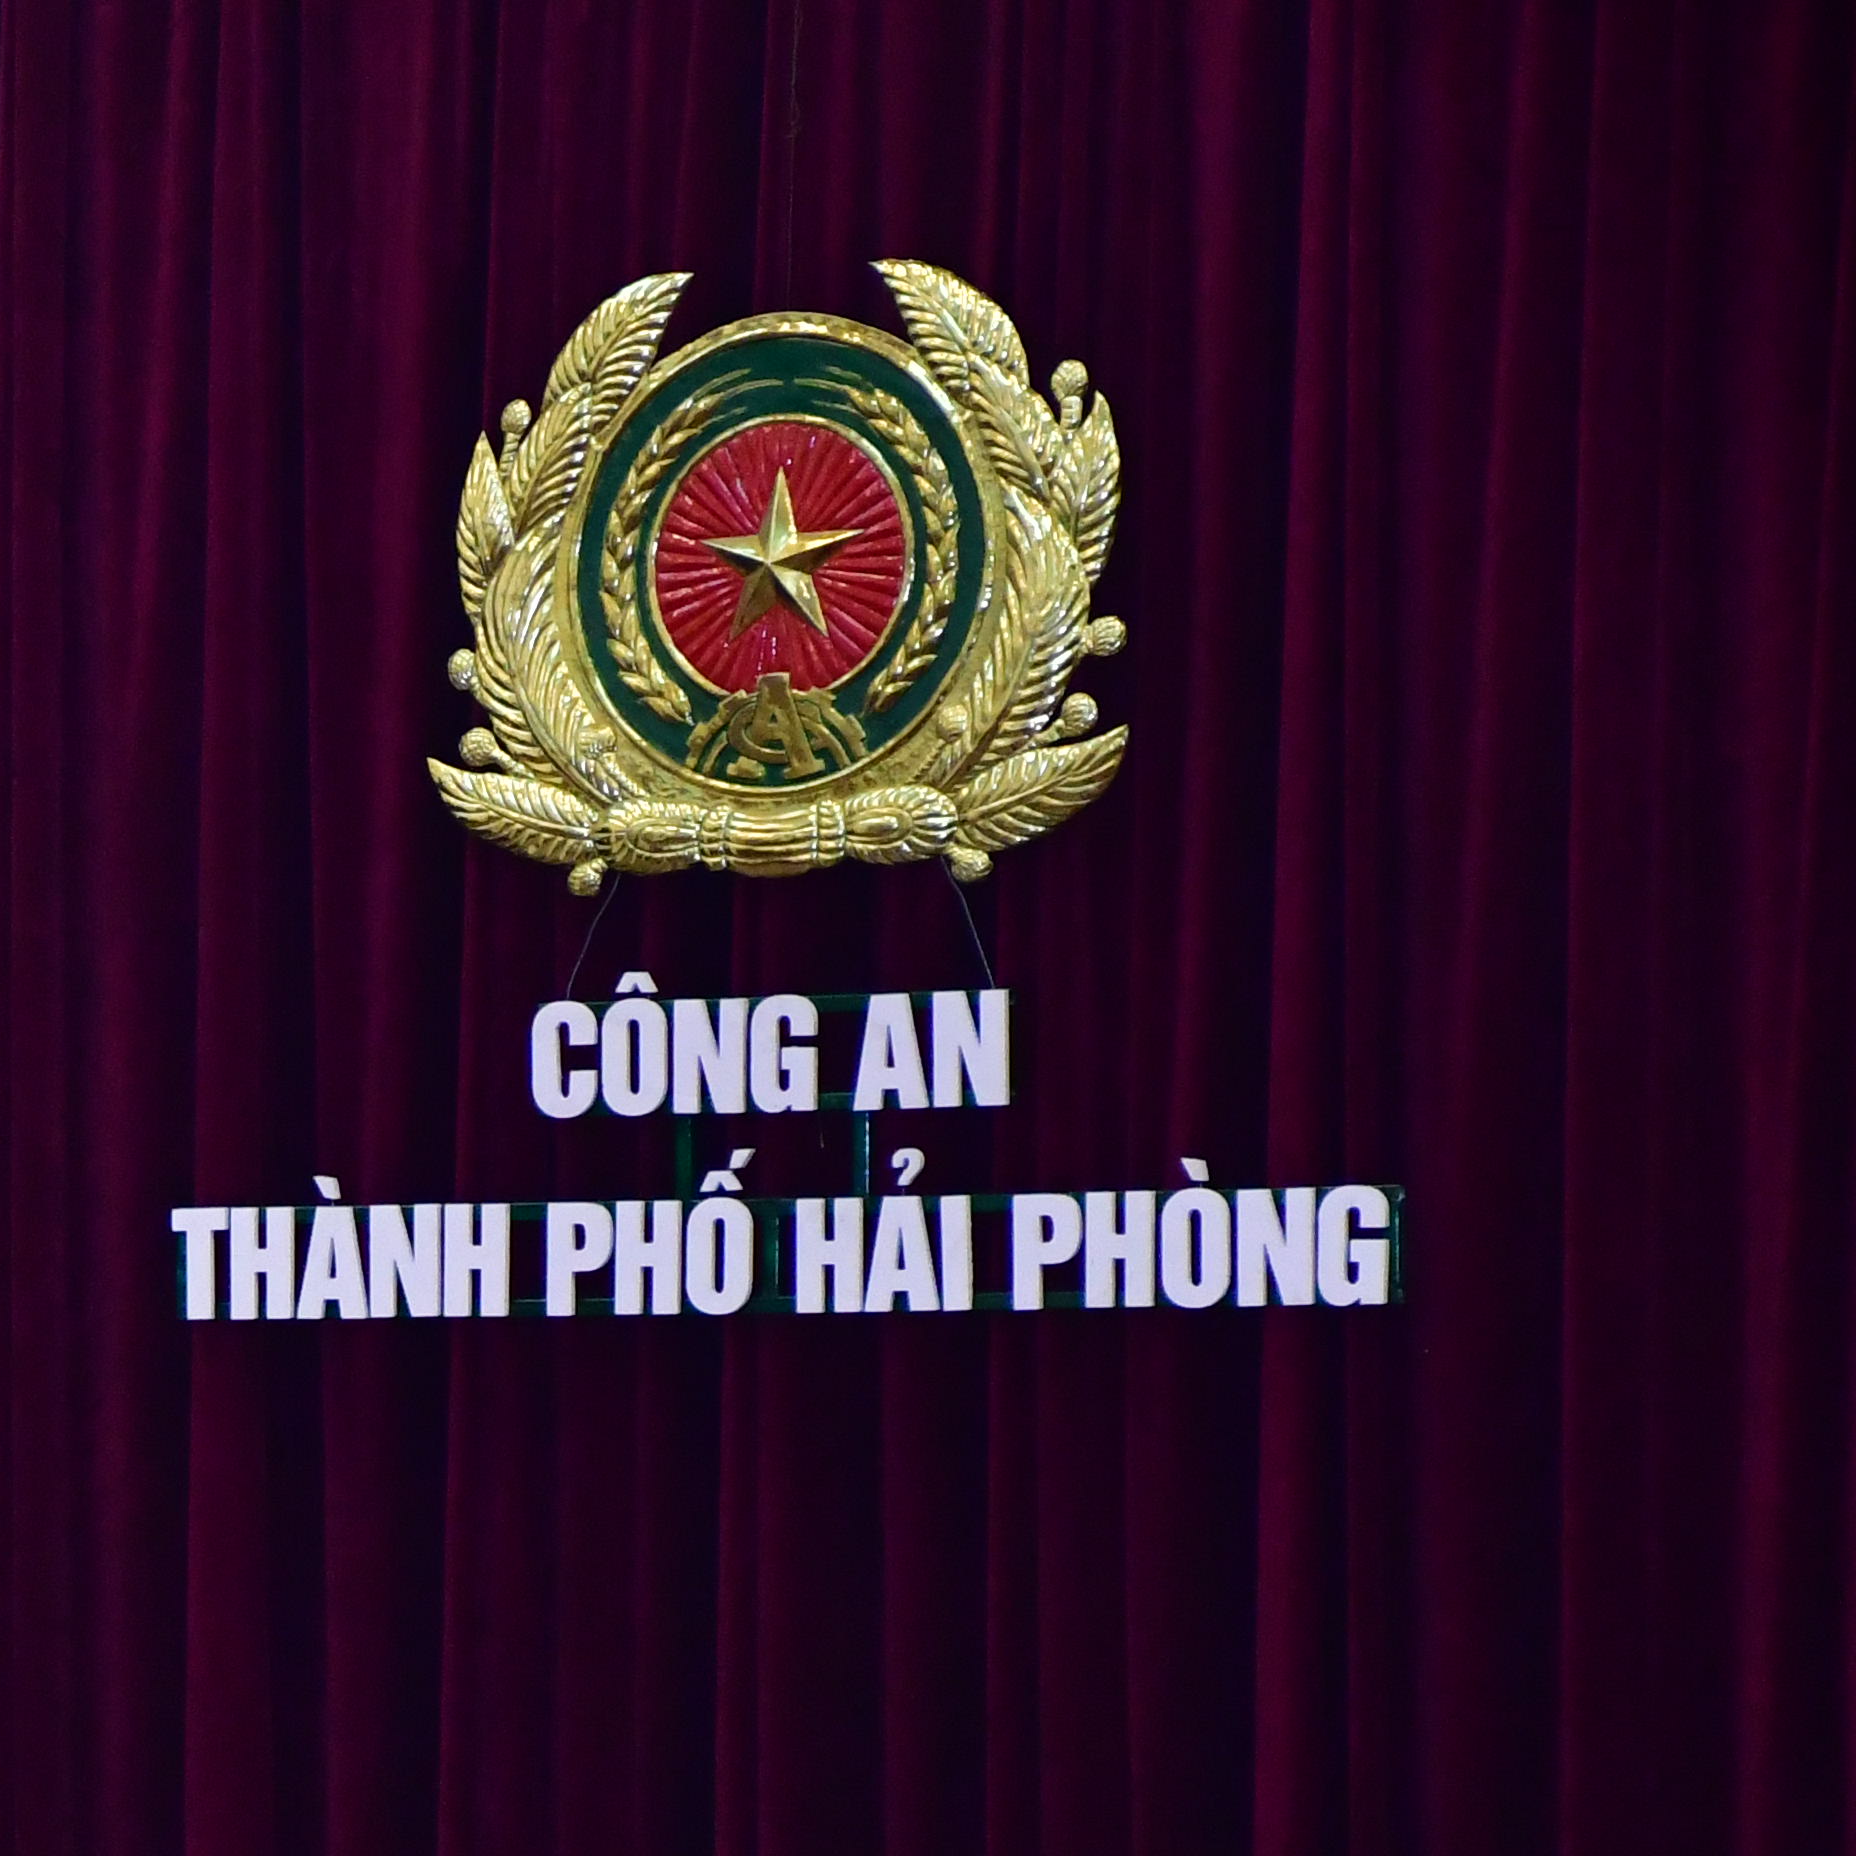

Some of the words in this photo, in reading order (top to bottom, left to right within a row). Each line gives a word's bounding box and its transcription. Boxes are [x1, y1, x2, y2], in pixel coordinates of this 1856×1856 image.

[532, 972, 818, 1118] CÔNG
[854, 989, 1009, 1110] AN
[172, 1176, 510, 1320] THÀNH
[547, 1149, 754, 1316] PHỐ
[796, 1148, 973, 1313] HẢI
[1013, 1158, 1389, 1310] PHÒNG
